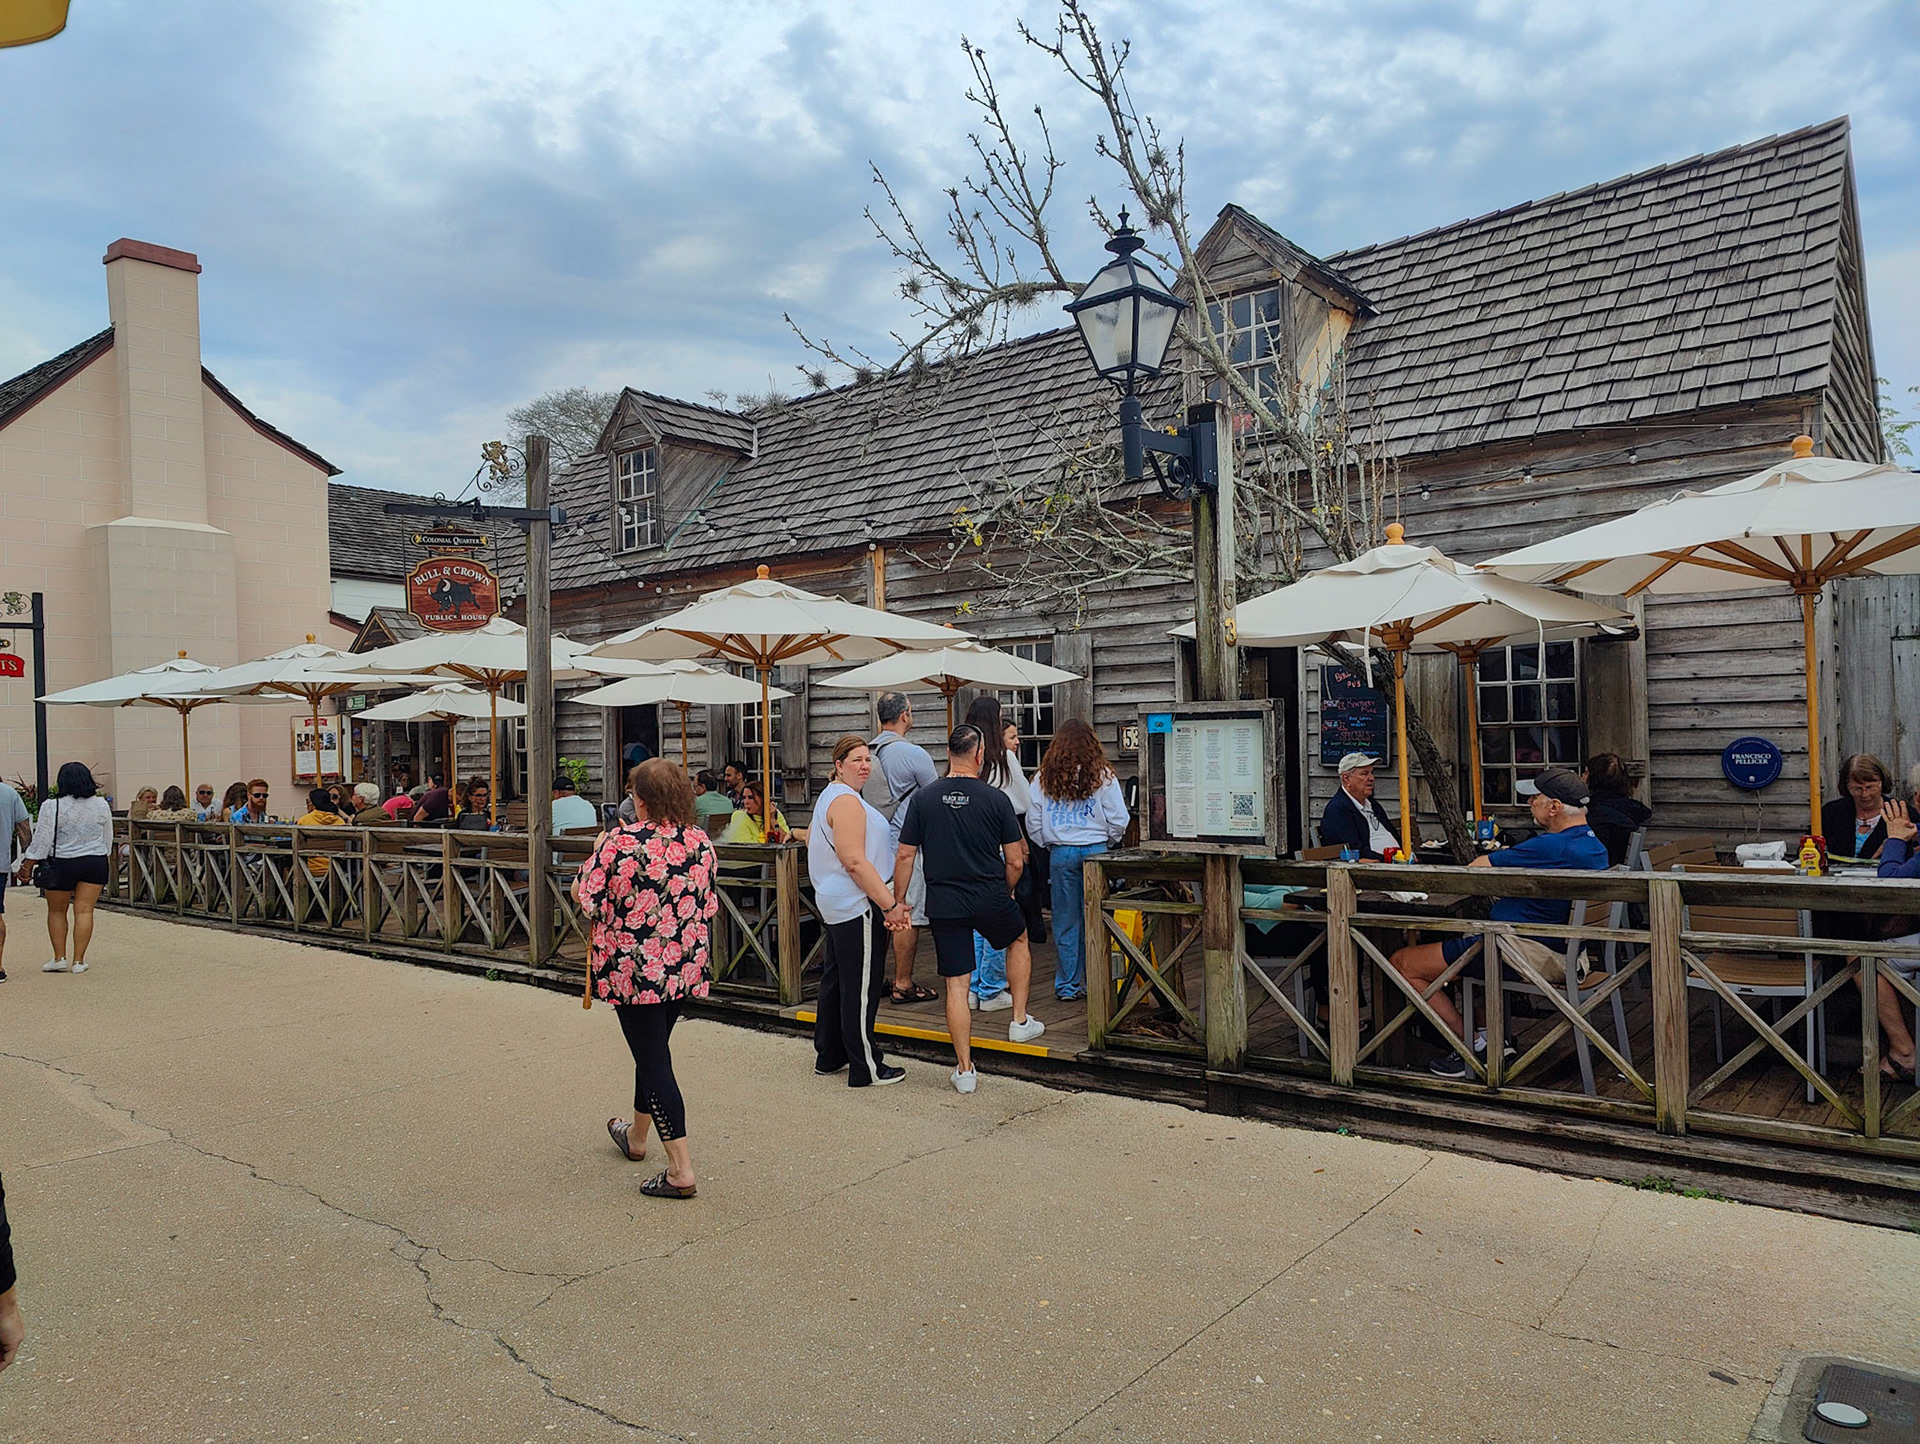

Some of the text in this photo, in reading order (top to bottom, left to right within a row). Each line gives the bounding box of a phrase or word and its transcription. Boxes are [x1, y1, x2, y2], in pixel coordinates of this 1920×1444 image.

[422, 536, 480, 545] COLONIAL QUARTER
[414, 566, 492, 586] BULL & CROWN
[1125, 729, 1139, 748] 53
[1340, 730, 1371, 740] SPECIALS
[1051, 811, 1088, 827] FEELS
